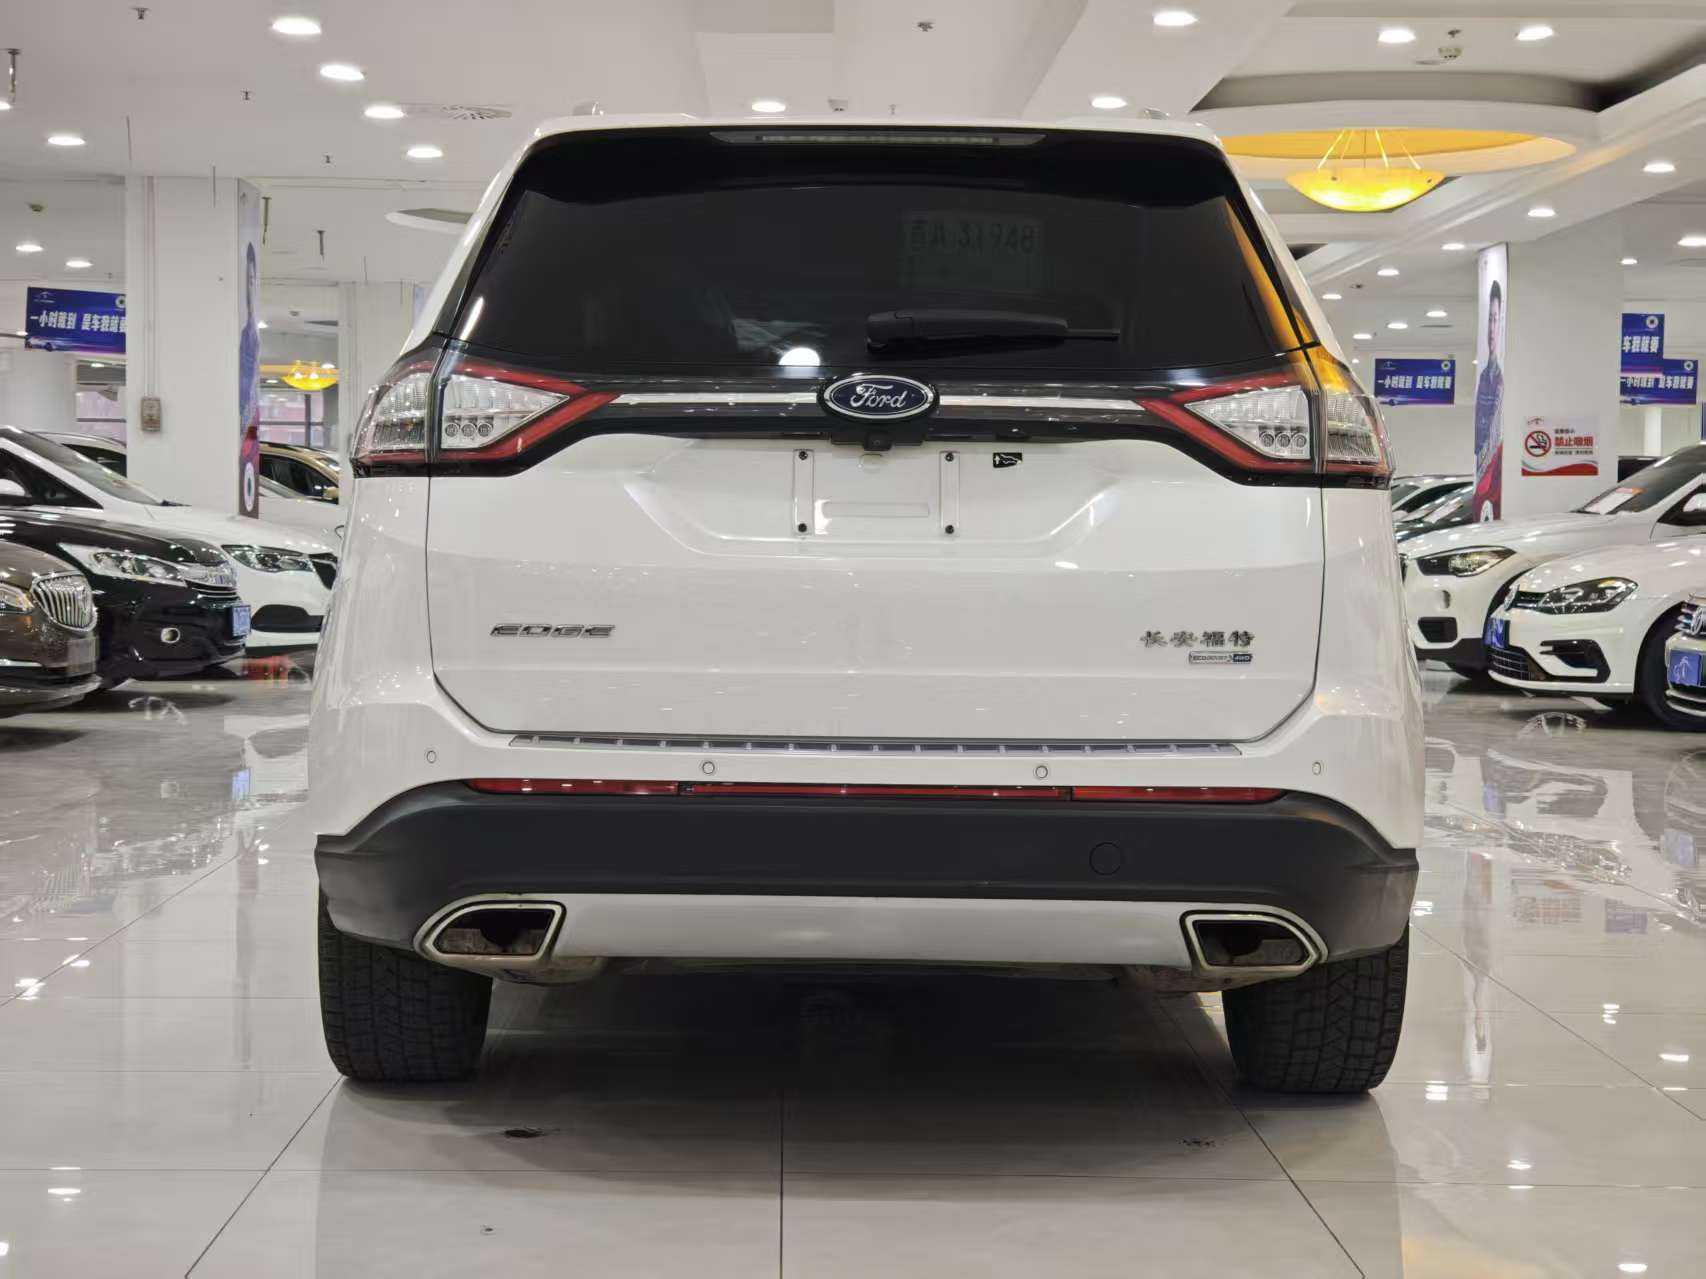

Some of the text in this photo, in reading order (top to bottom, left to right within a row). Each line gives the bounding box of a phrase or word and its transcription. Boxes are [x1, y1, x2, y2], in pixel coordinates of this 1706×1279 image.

[850, 383, 908, 407] Ford
[490, 623, 615, 638] EDGE
[1140, 631, 1255, 648] 长安福特
